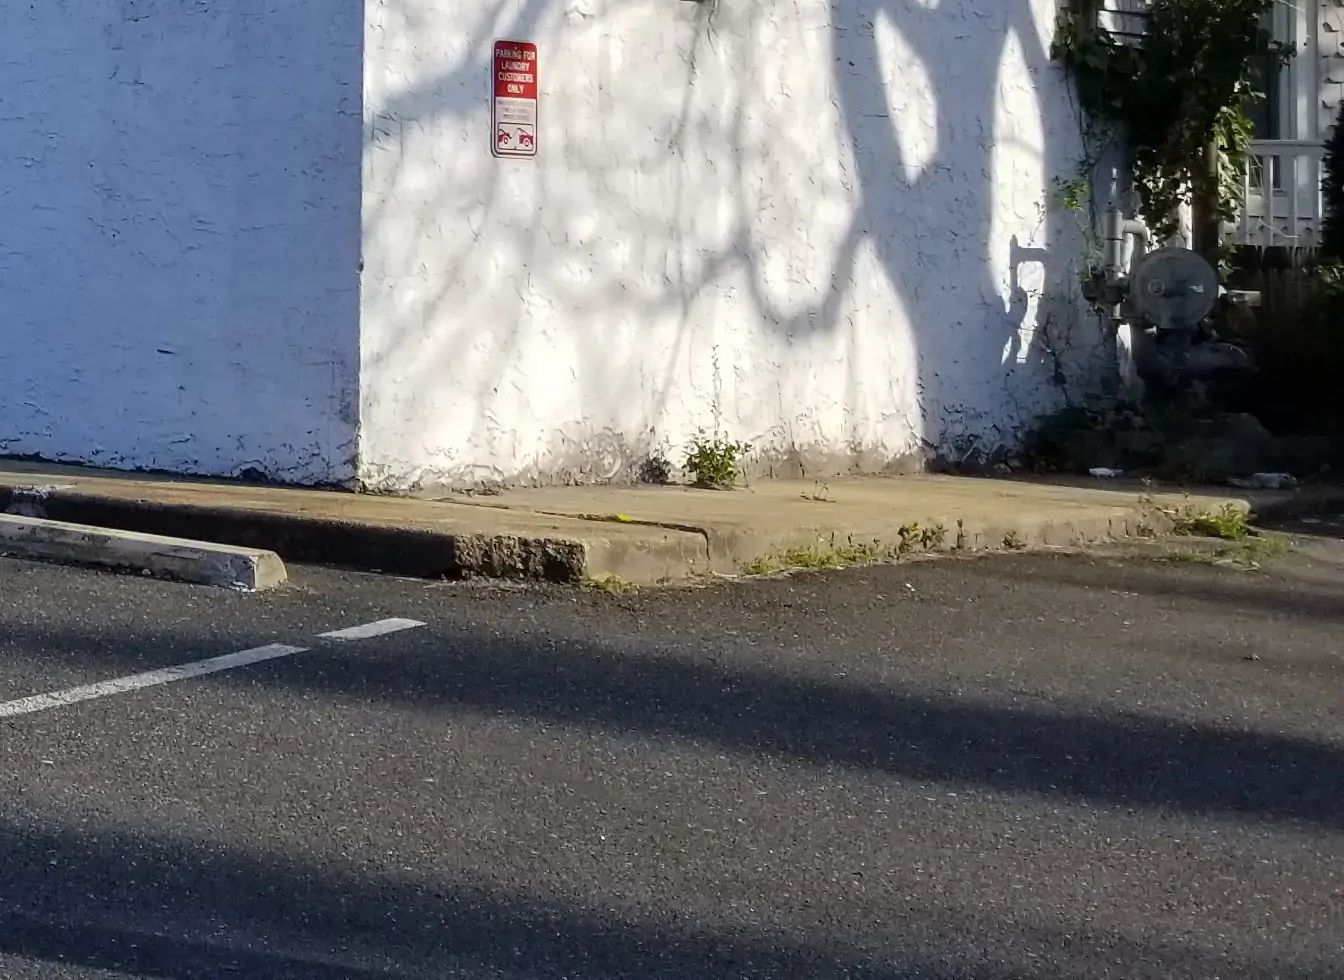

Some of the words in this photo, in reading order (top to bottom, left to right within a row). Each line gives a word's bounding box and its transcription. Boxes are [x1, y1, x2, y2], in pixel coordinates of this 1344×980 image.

[495, 48, 523, 59] PARKING
[523, 51, 536, 61] FOR
[501, 61, 530, 71] LAUNDRY
[507, 83, 525, 94] ONLY
